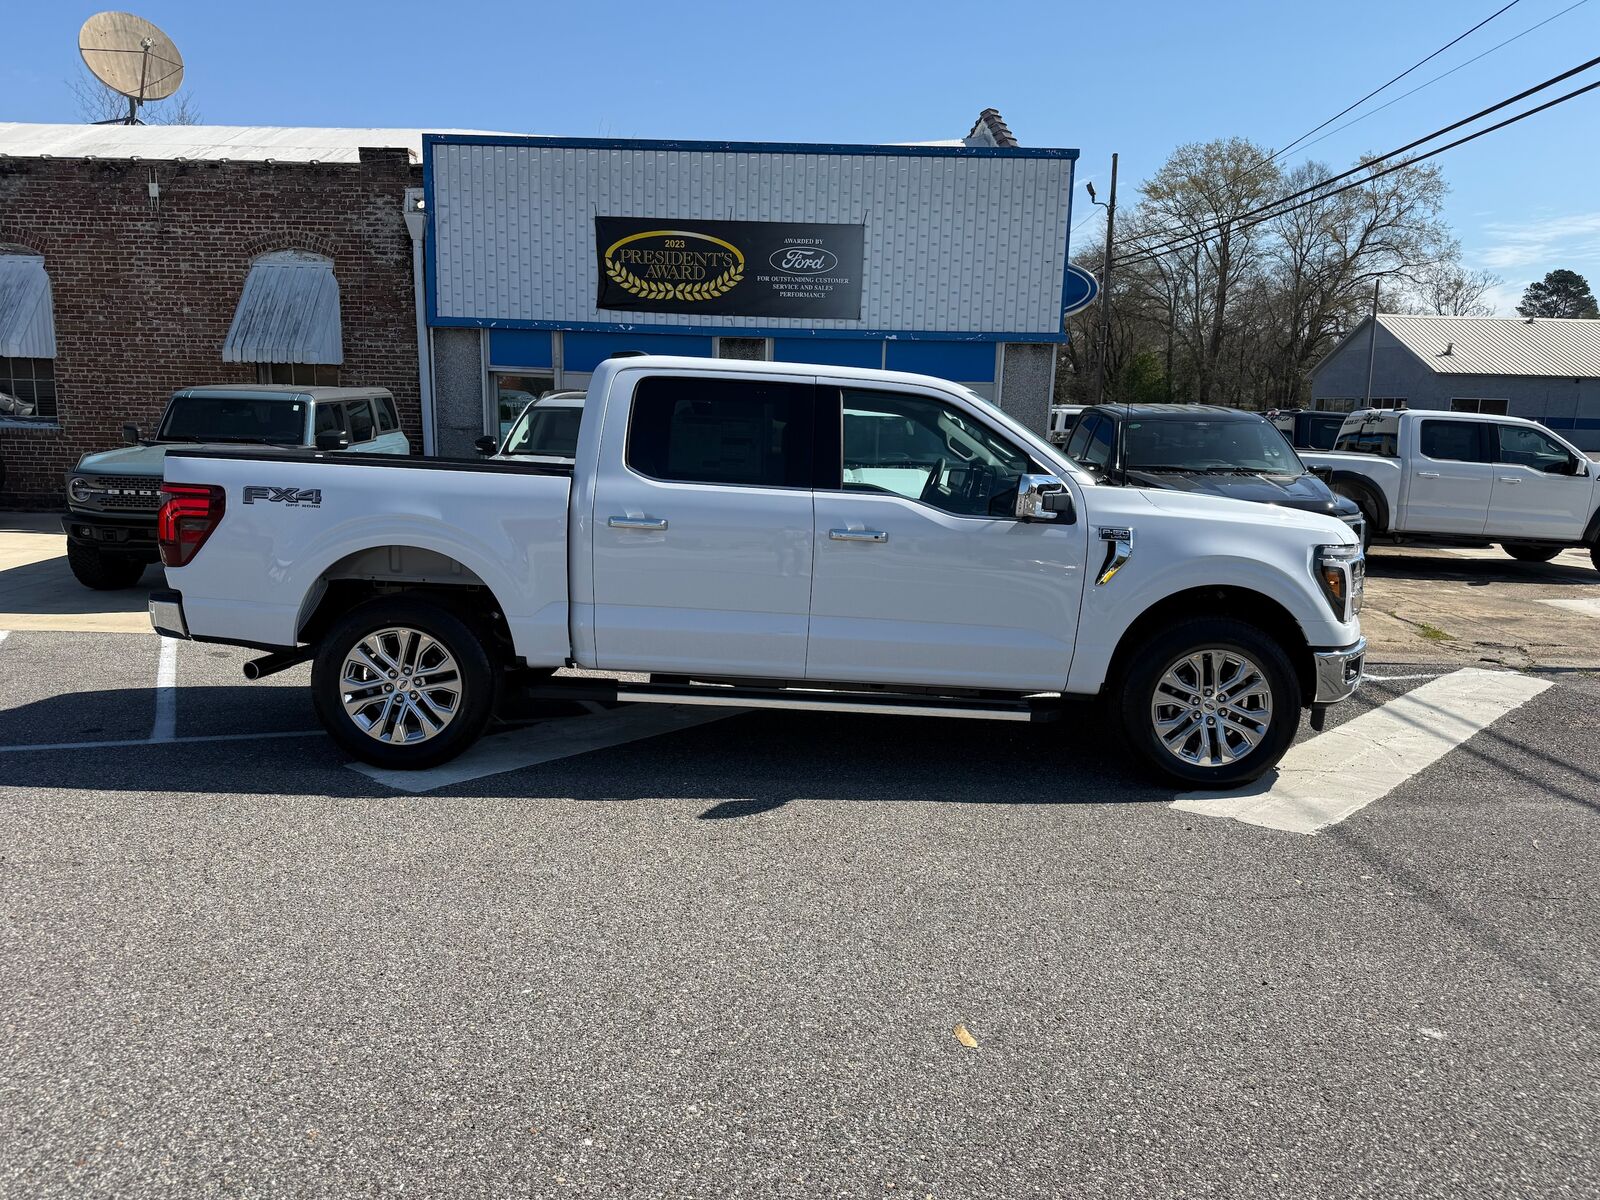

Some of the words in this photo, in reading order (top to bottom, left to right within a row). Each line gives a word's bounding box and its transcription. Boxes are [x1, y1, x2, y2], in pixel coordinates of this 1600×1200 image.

[664, 239, 686, 248] 2023
[620, 249, 733, 267] PRESIDENT'S
[781, 249, 825, 269] Ford
[644, 264, 706, 280] AWARD
[242, 485, 322, 504] FX4
